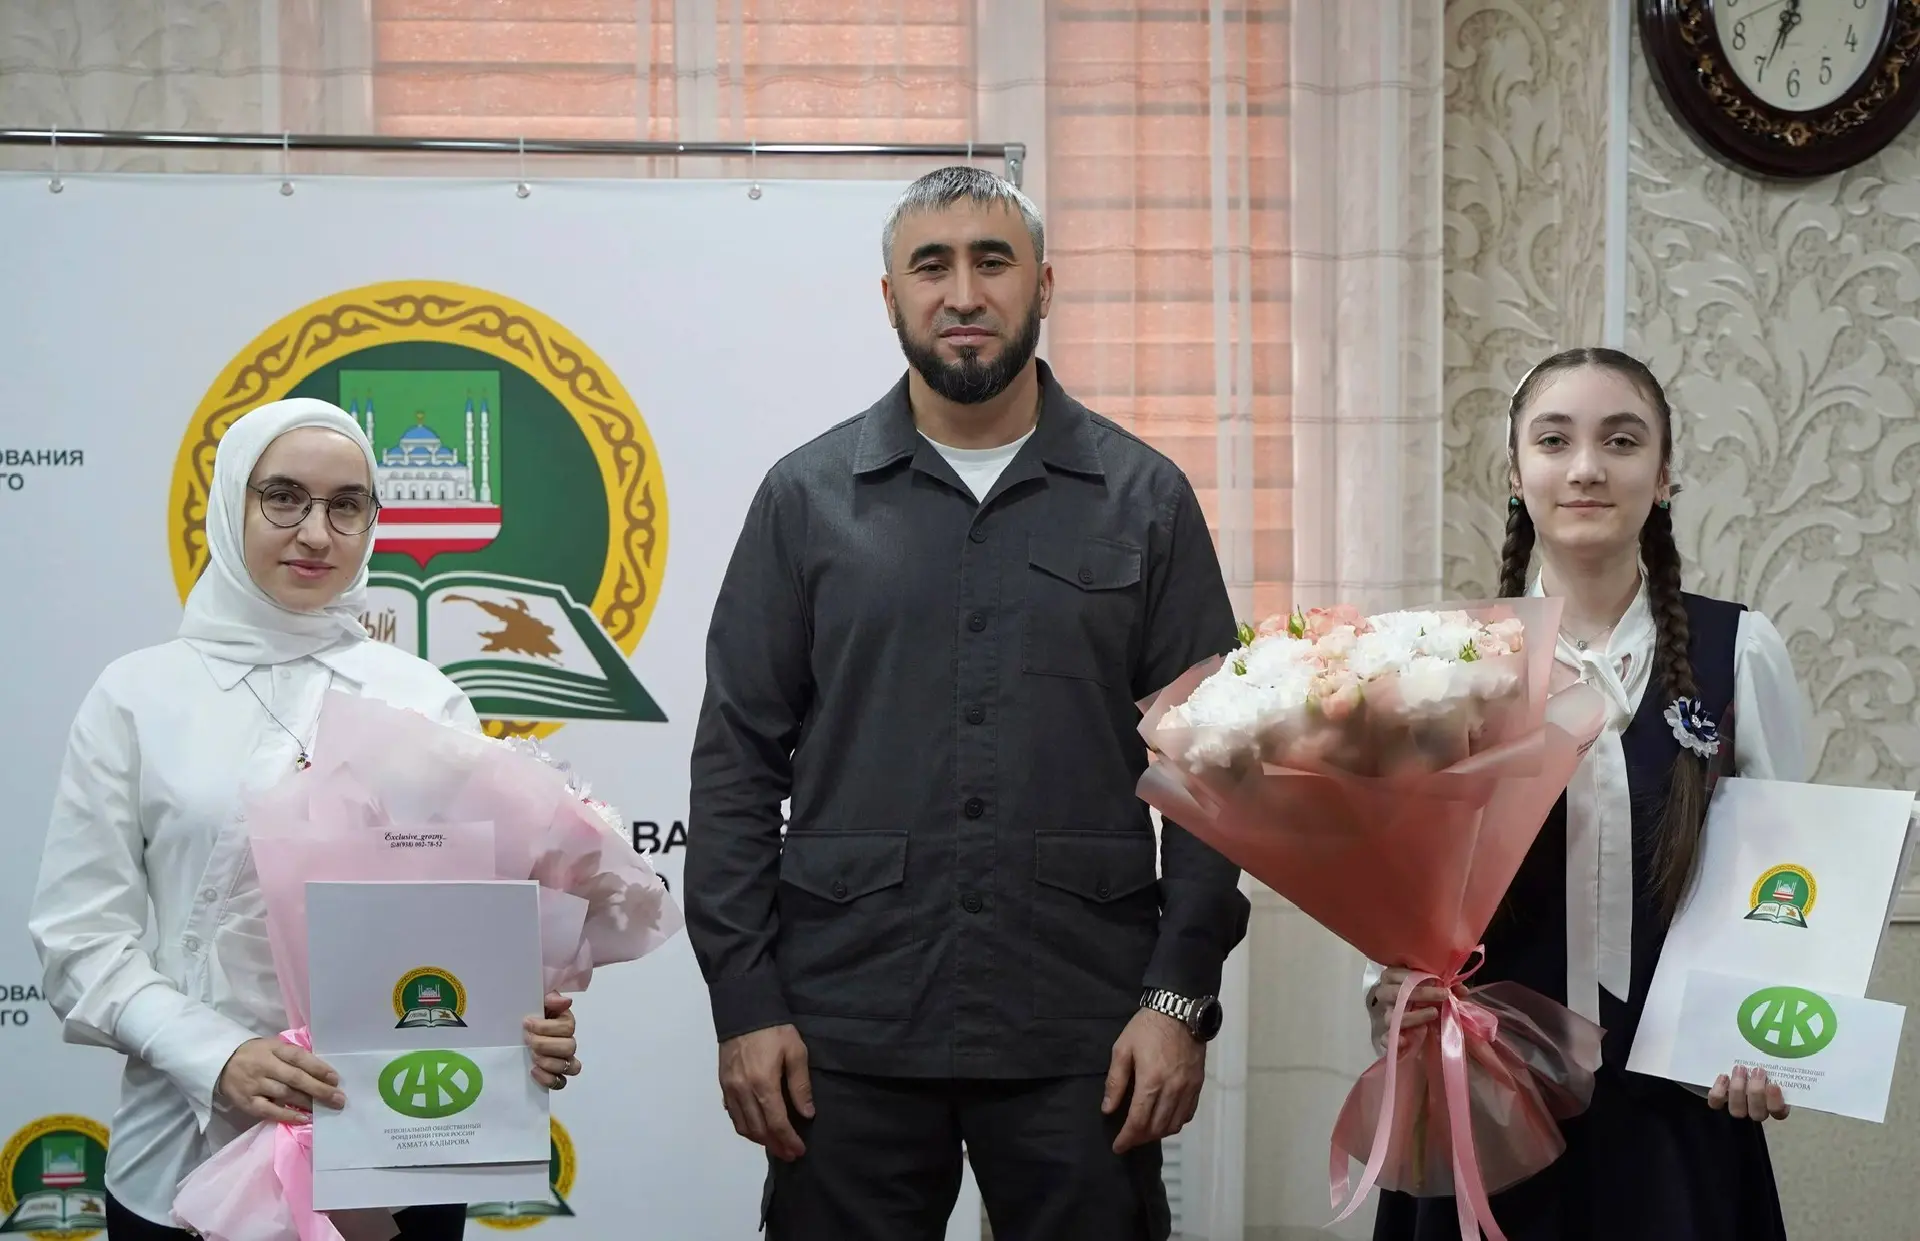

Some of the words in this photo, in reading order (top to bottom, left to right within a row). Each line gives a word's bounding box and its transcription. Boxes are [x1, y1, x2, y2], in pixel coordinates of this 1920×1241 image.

[1733, 22, 1746, 50] 8
[1844, 24, 1858, 52] 4
[1754, 56, 1766, 83] 7
[1786, 68, 1800, 97] 6
[1819, 57, 1832, 85] 5
[0, 449, 84, 466] ВАНИЯ
